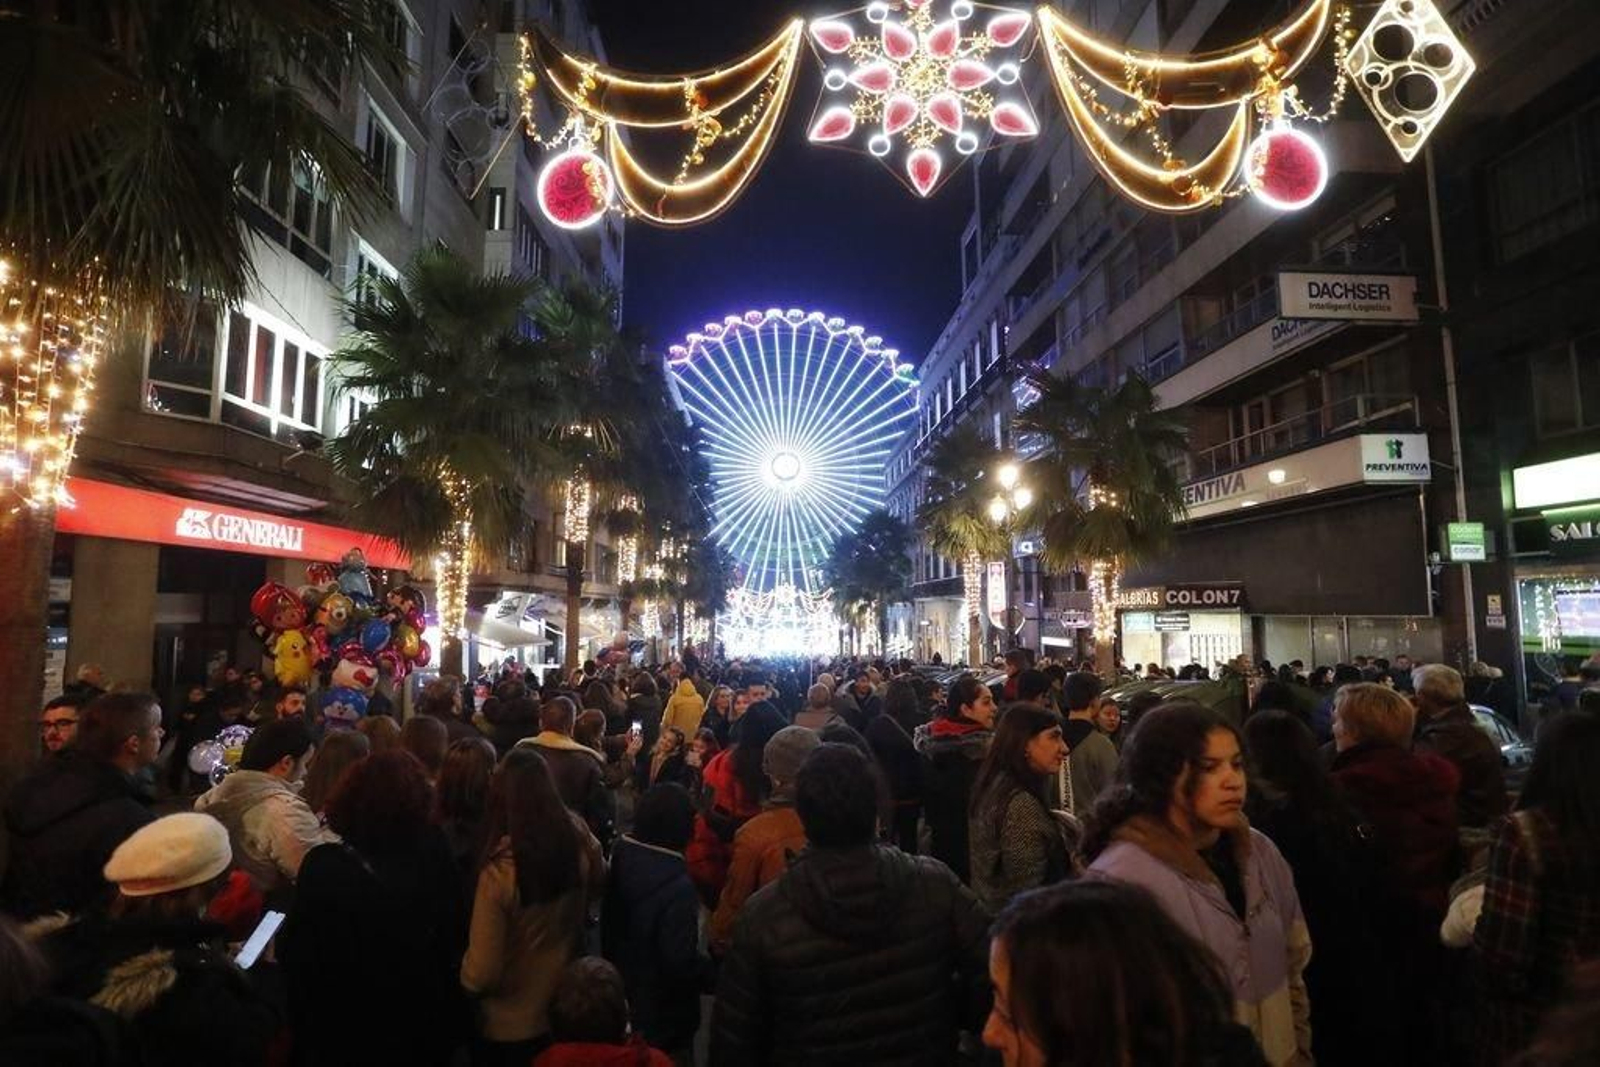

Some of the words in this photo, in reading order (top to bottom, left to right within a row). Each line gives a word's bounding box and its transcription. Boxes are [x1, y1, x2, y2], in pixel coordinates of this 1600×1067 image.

[1308, 282, 1390, 300] DACHSER
[1309, 302, 1351, 312] Intelligent
[1353, 303, 1392, 312] Logistics
[1365, 463, 1429, 472] PREVENTIVA
[213, 515, 303, 551] GENERALI
[1549, 521, 1600, 542] SAL
